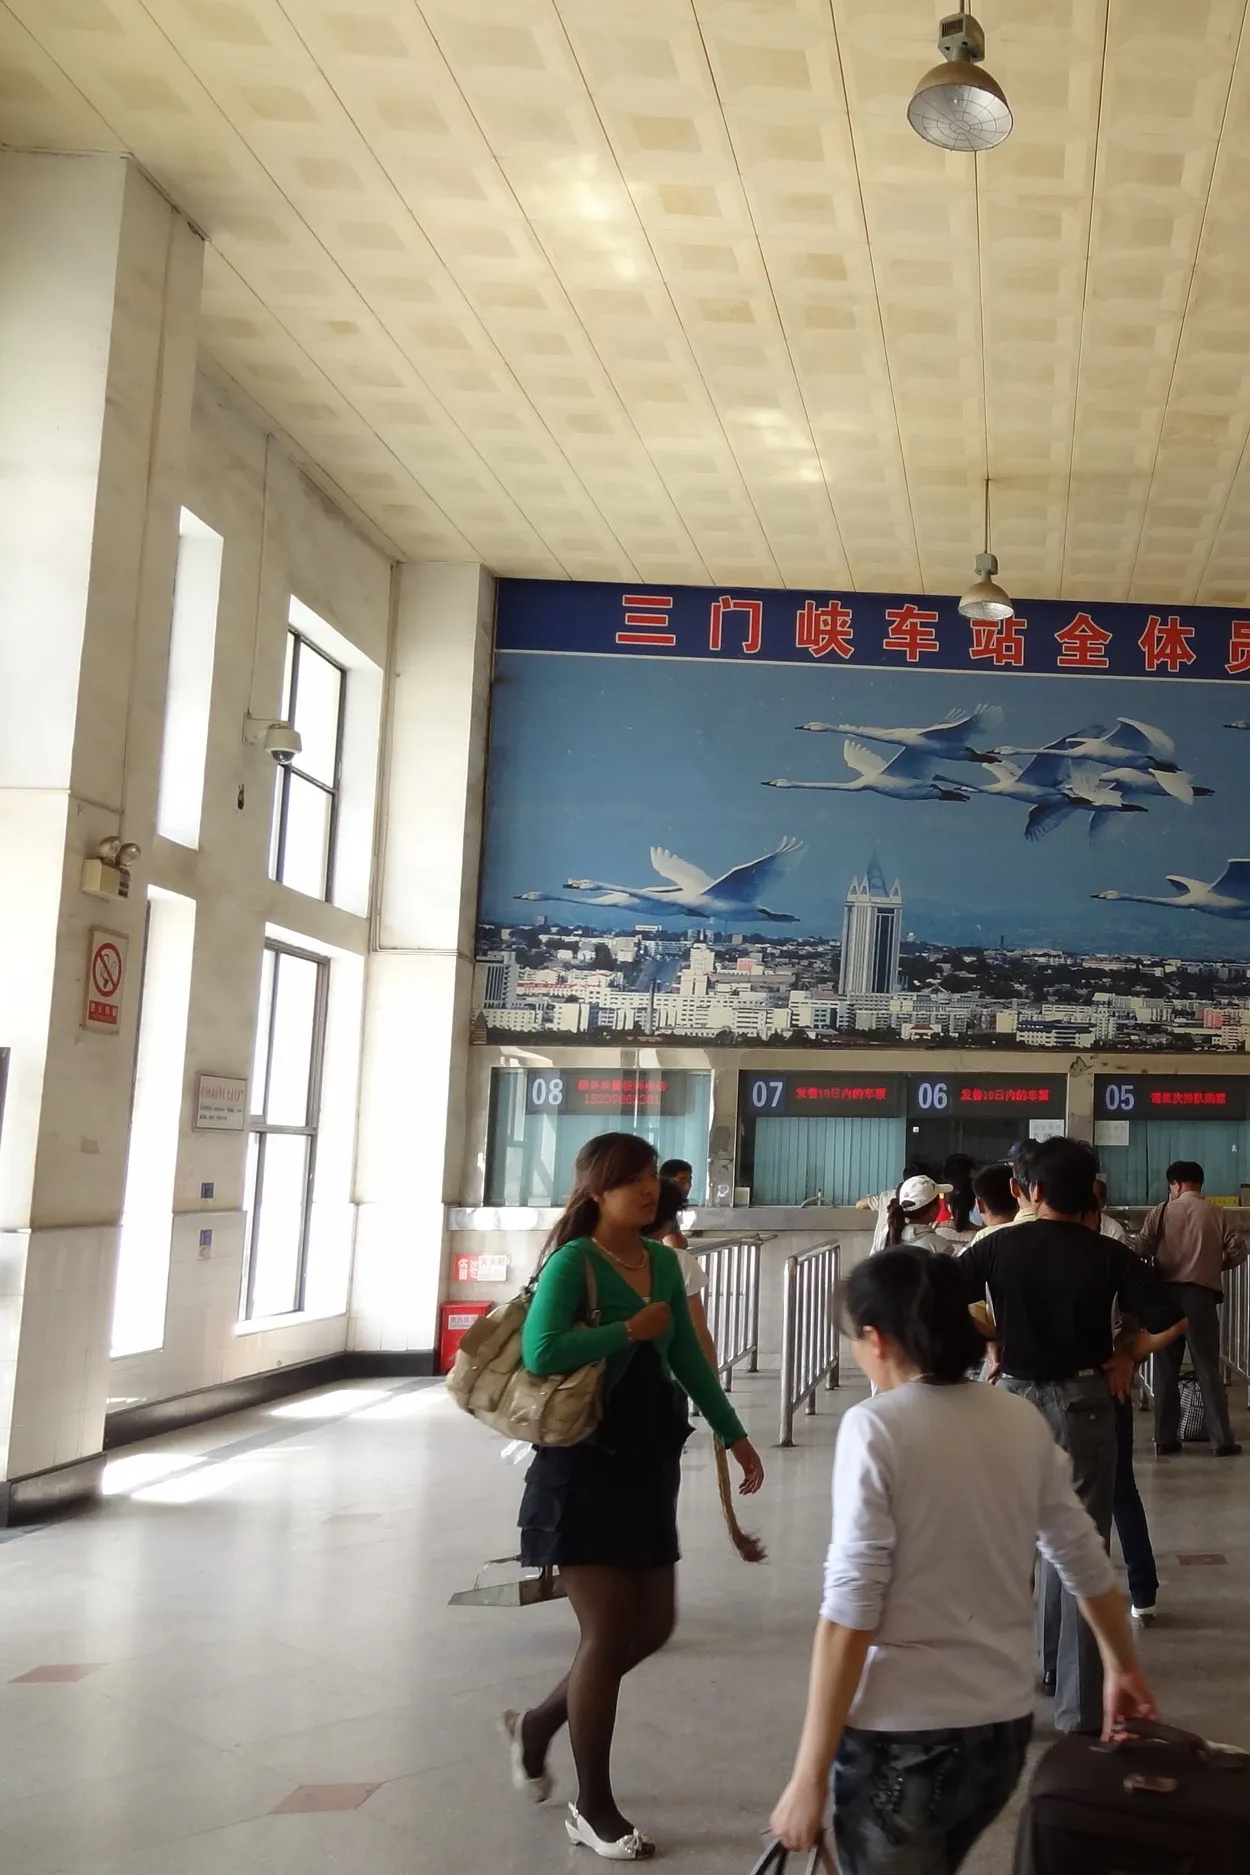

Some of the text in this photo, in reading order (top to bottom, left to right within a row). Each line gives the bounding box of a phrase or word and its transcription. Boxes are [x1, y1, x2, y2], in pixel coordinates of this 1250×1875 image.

[532, 1078, 564, 1105] 08
[752, 1080, 784, 1108] 07
[918, 1082, 948, 1109] 06
[960, 1088, 1050, 1102] 发售10日内的车票
[1105, 1084, 1135, 1111] 05
